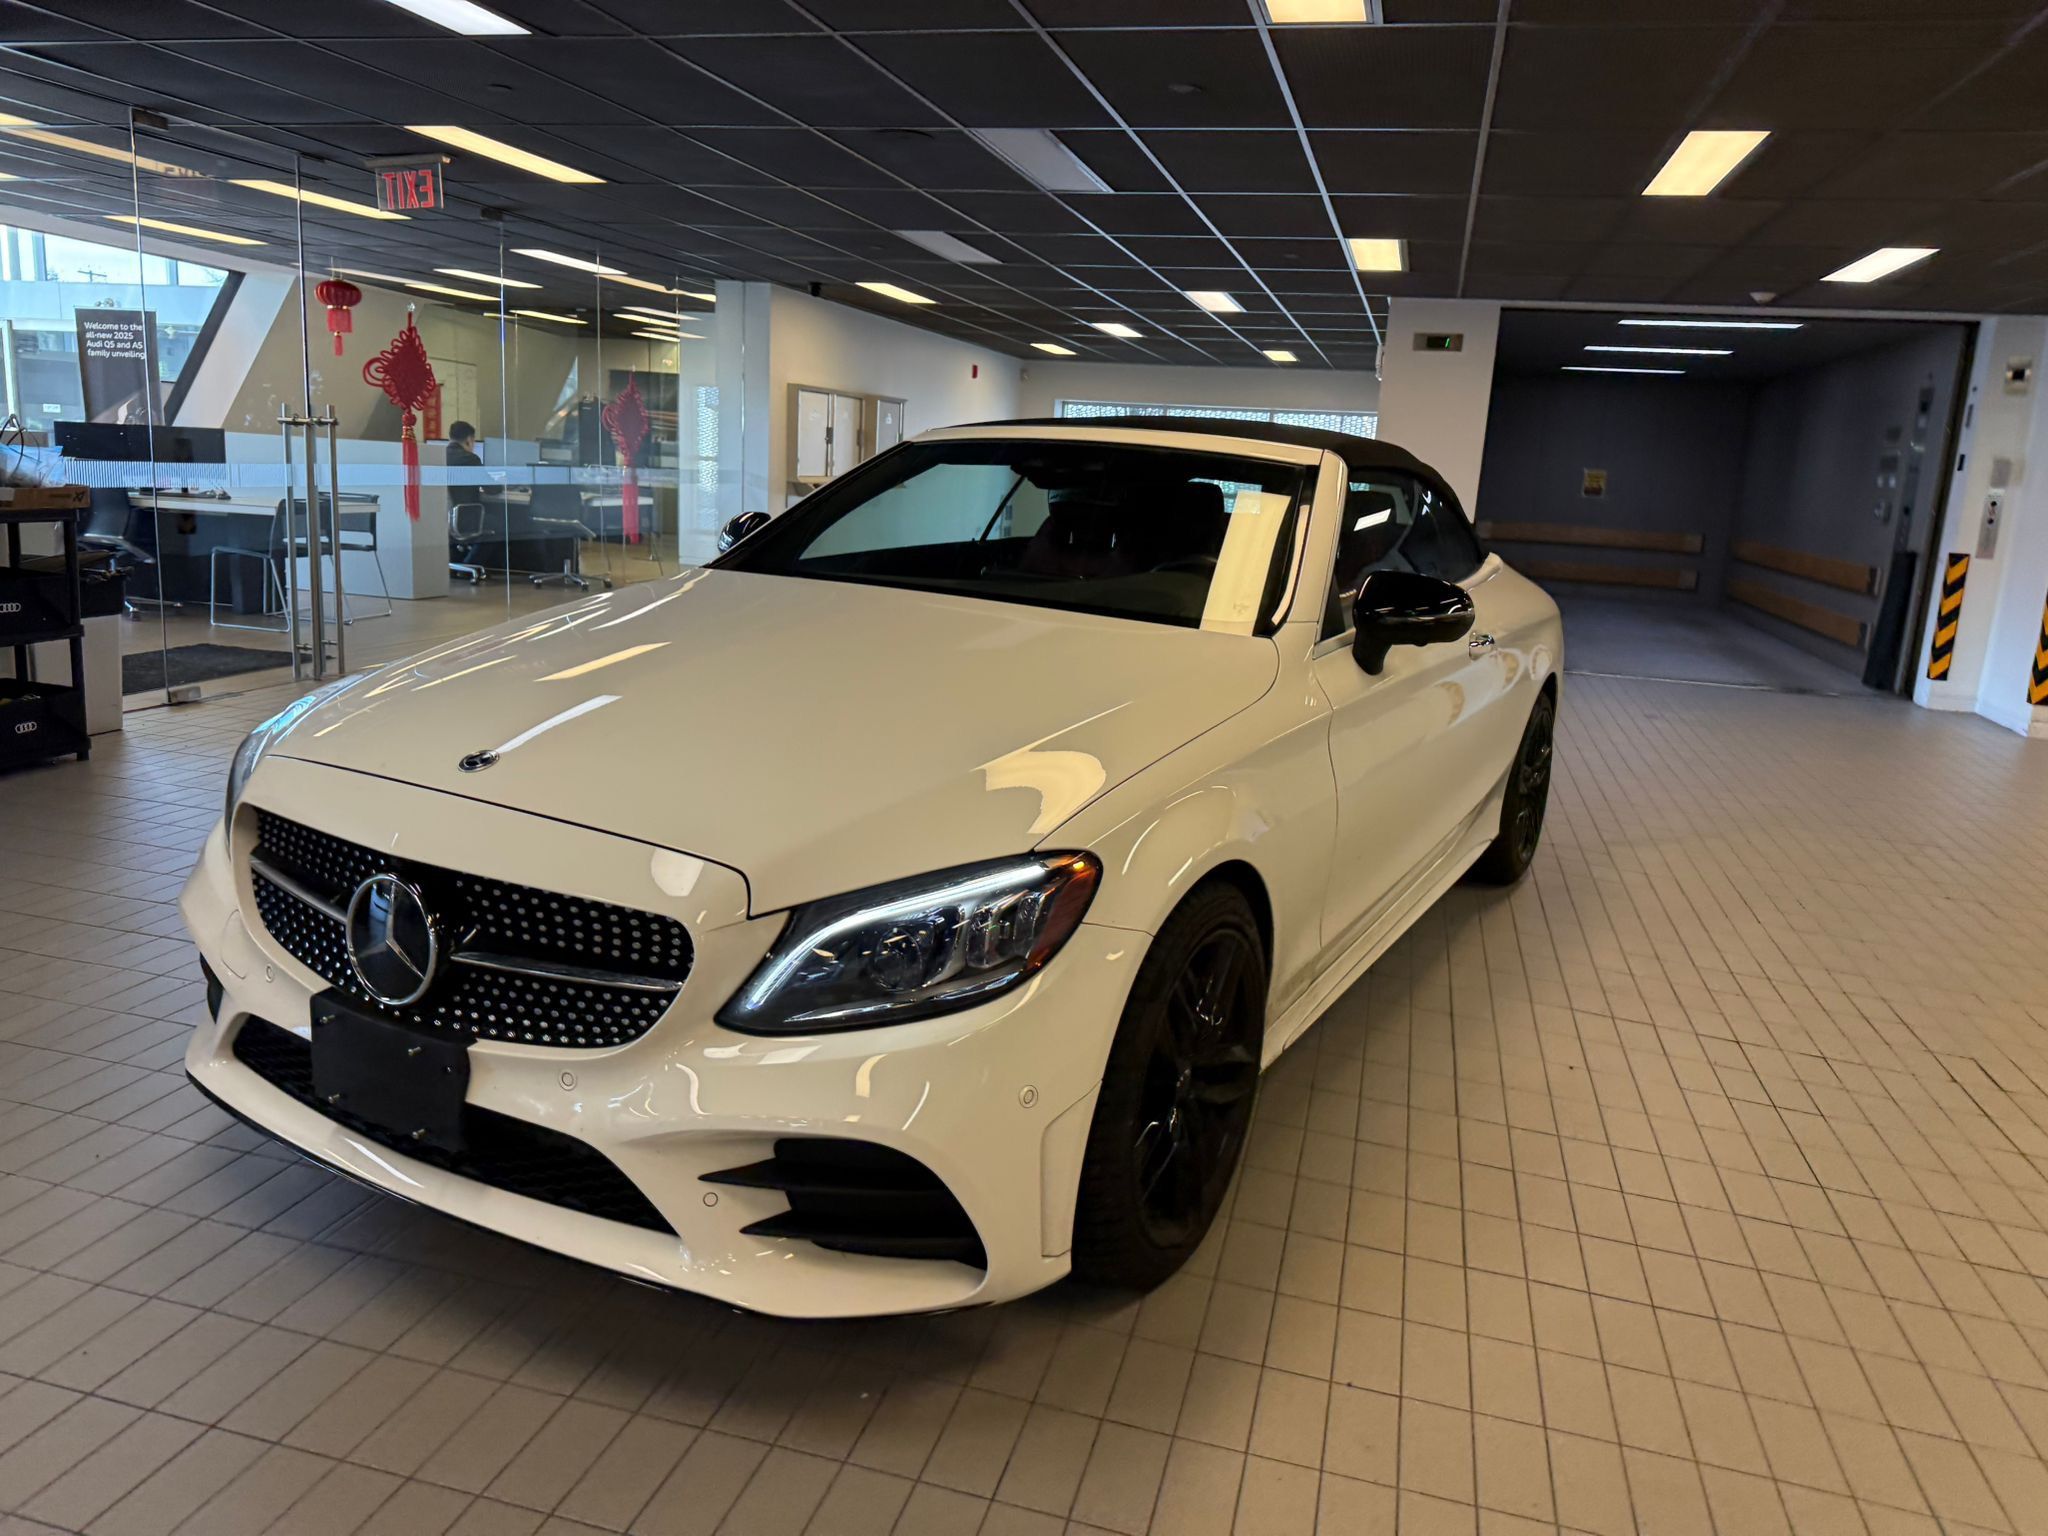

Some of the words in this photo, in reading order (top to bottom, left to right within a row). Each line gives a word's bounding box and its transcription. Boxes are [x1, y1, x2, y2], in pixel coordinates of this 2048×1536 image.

[84, 322, 118, 330] Welcome
[130, 323, 143, 331] the
[86, 340, 103, 348] Audi
[104, 340, 115, 349] Q5
[116, 341, 131, 349] and
[132, 341, 143, 349] A5
[87, 349, 110, 358] family
[112, 350, 146, 360] unveiling
